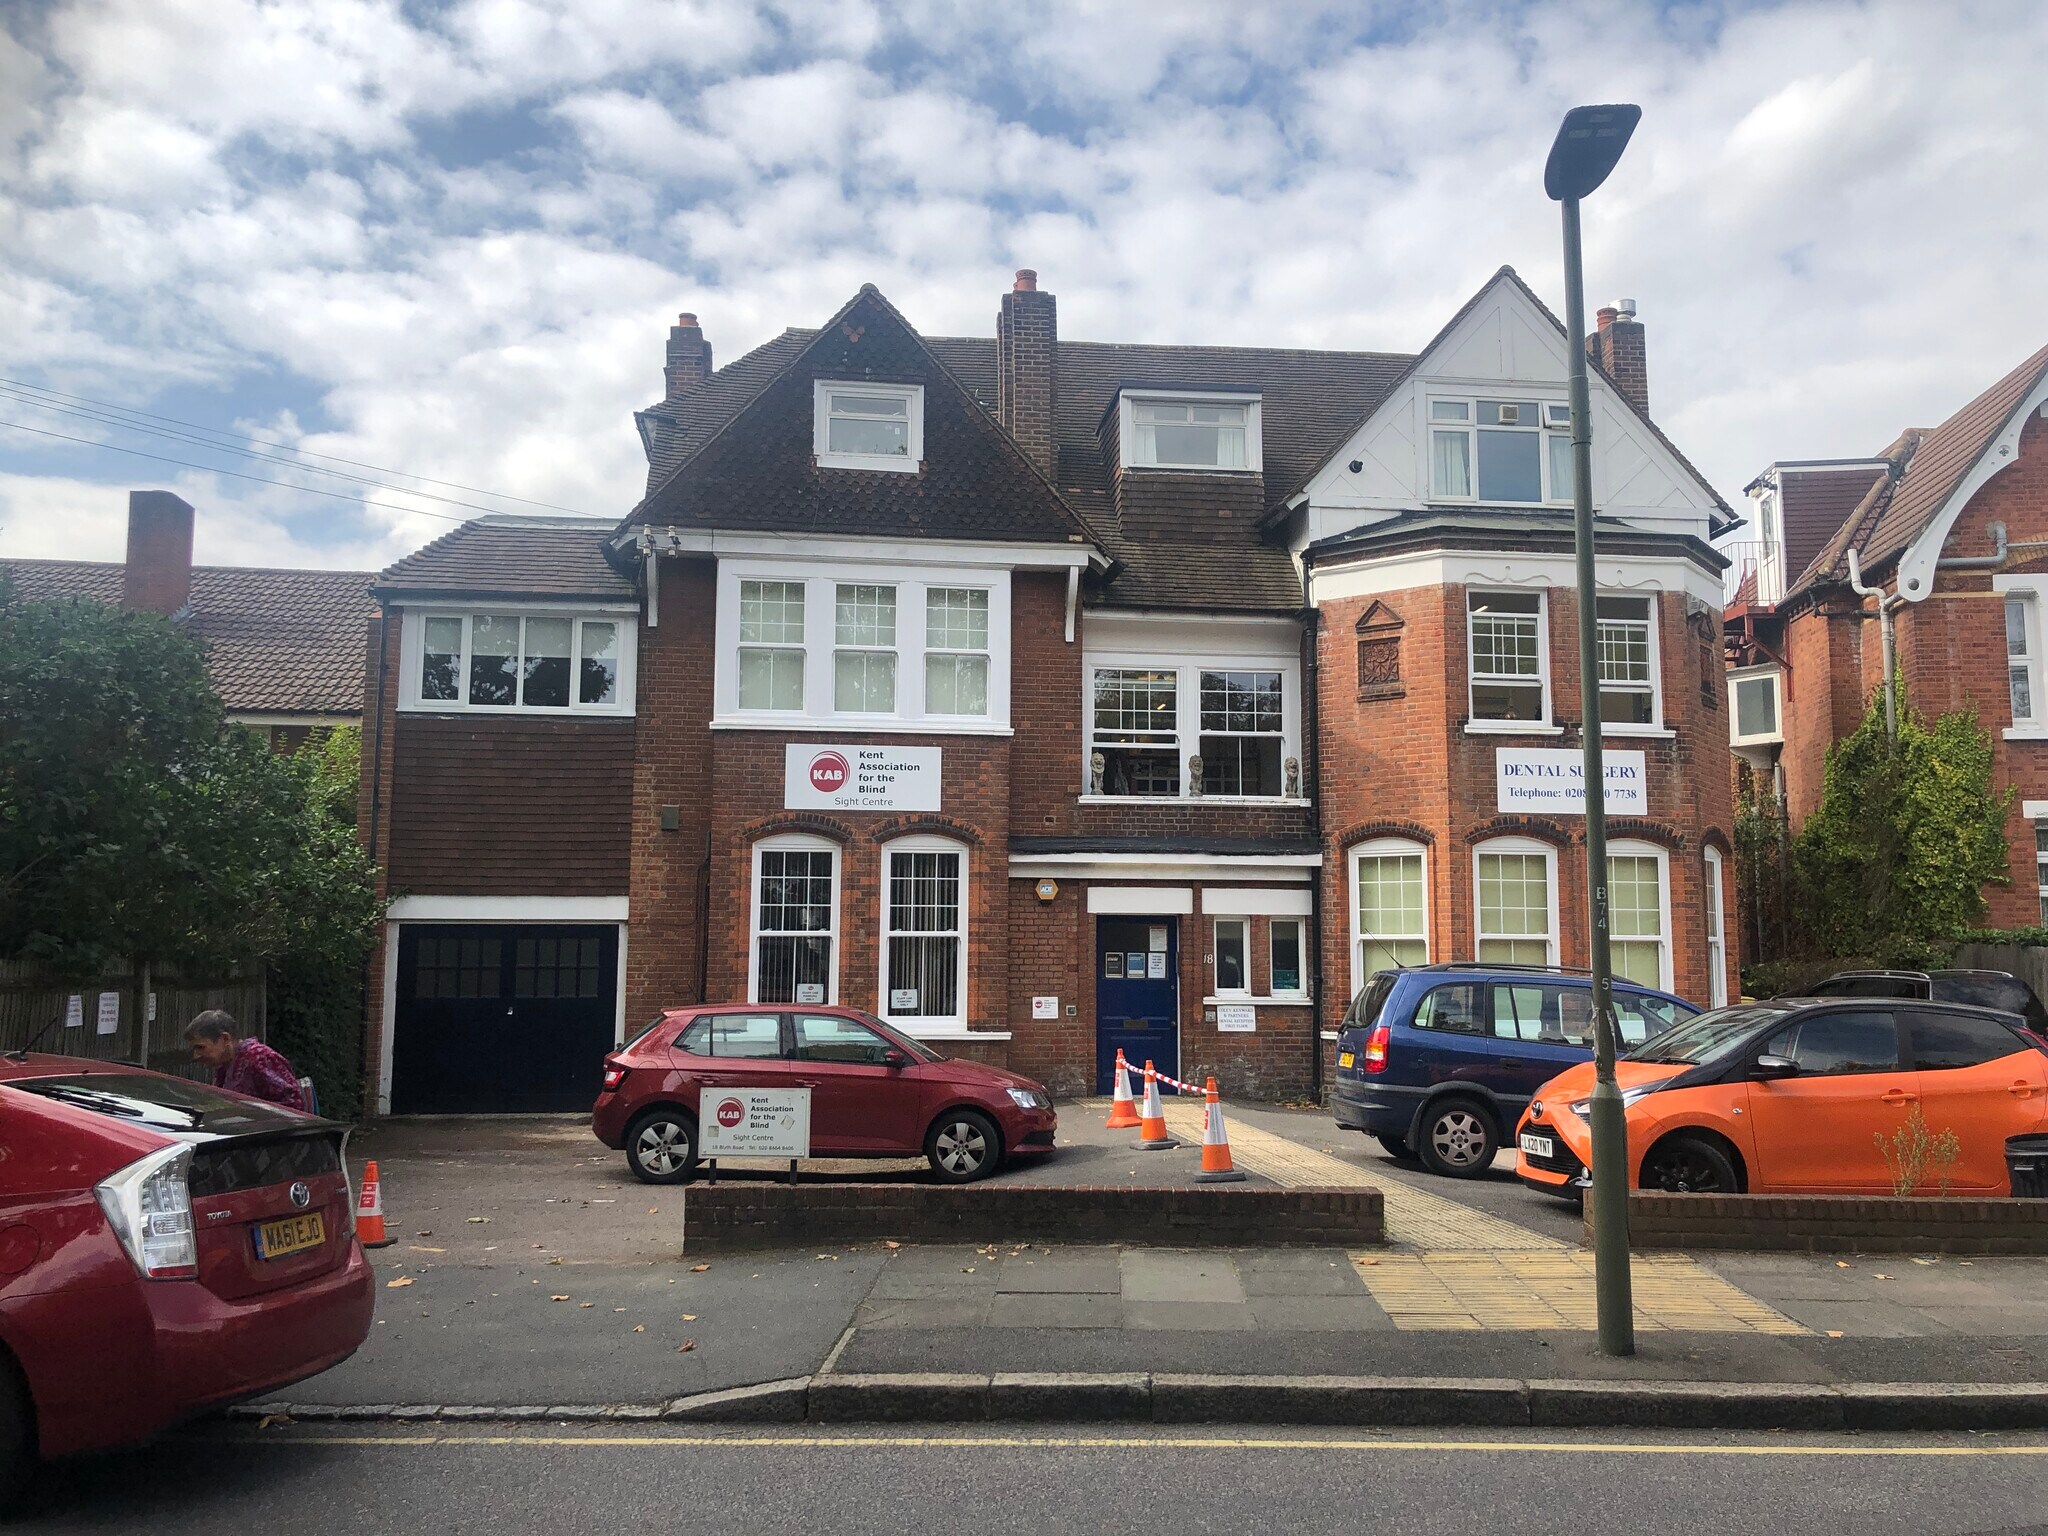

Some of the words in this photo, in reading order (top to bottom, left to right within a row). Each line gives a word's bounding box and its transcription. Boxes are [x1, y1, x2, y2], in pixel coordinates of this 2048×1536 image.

[859, 750, 884, 759] Kent
[858, 762, 920, 771] Association
[1504, 764, 1565, 777] DENTAL
[1569, 765, 1639, 778] SUGERY
[813, 769, 843, 781] KAB
[858, 774, 874, 782] for
[877, 774, 895, 782] the
[858, 785, 886, 794] Blind
[1508, 787, 1561, 799] Telephone:
[1614, 789, 1637, 799] 7738
[834, 797, 859, 807] Sight
[862, 797, 894, 806] Centre
[1203, 953, 1214, 964] 18
[719, 1111, 740, 1119] KAB
[733, 1134, 750, 1142] Sight
[1539, 1139, 1550, 1154] YNT
[207, 1210, 232, 1220] TOYOTA
